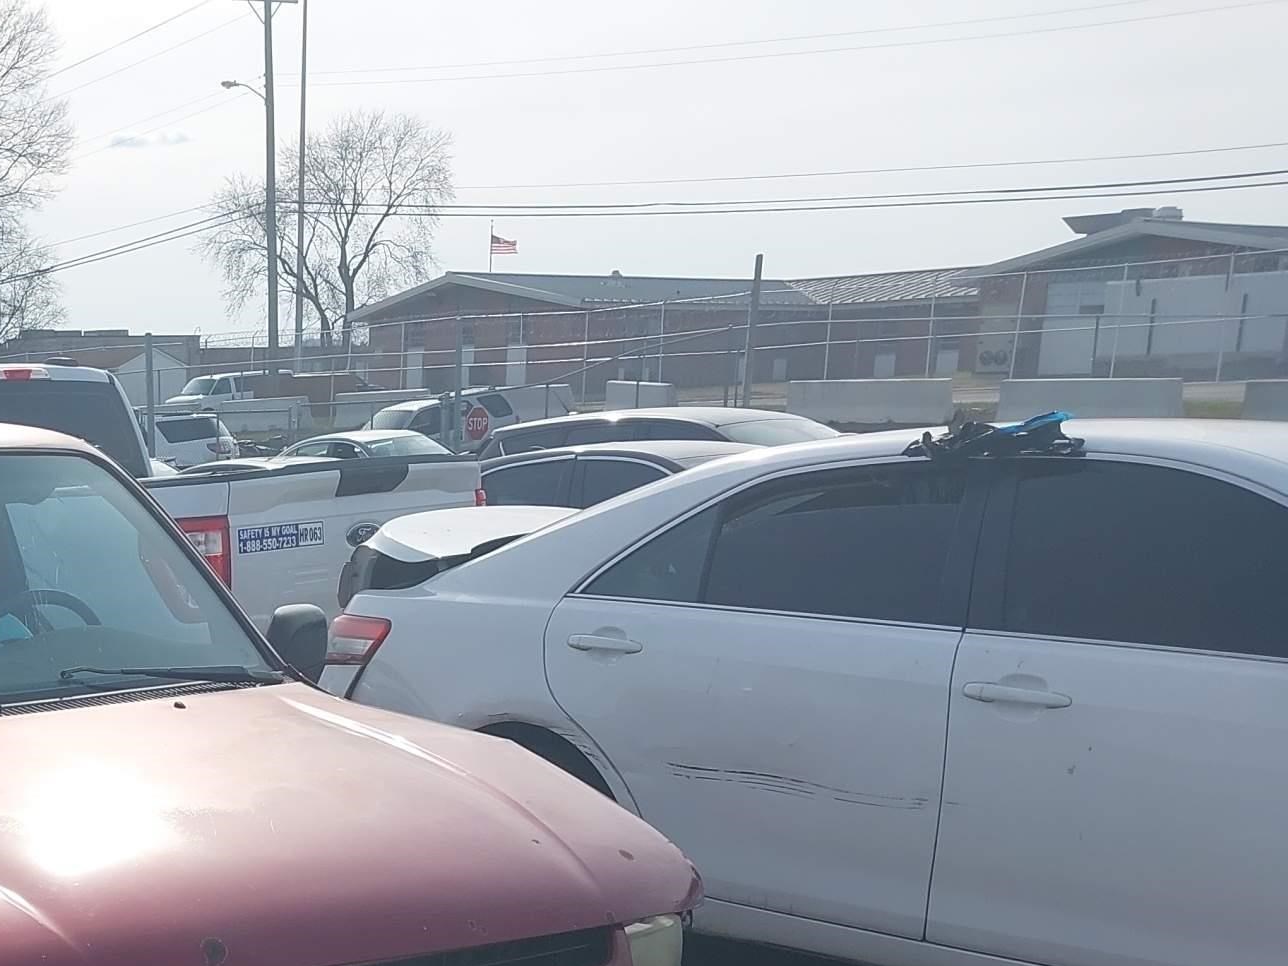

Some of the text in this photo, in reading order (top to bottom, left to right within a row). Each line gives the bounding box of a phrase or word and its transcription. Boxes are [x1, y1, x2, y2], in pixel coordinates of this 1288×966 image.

[468, 417, 488, 431] STOP
[239, 525, 297, 540] SAFETY IS MY GOAL
[299, 526, 322, 543] HR 063
[239, 536, 297, 553] 1-888-550-7233
